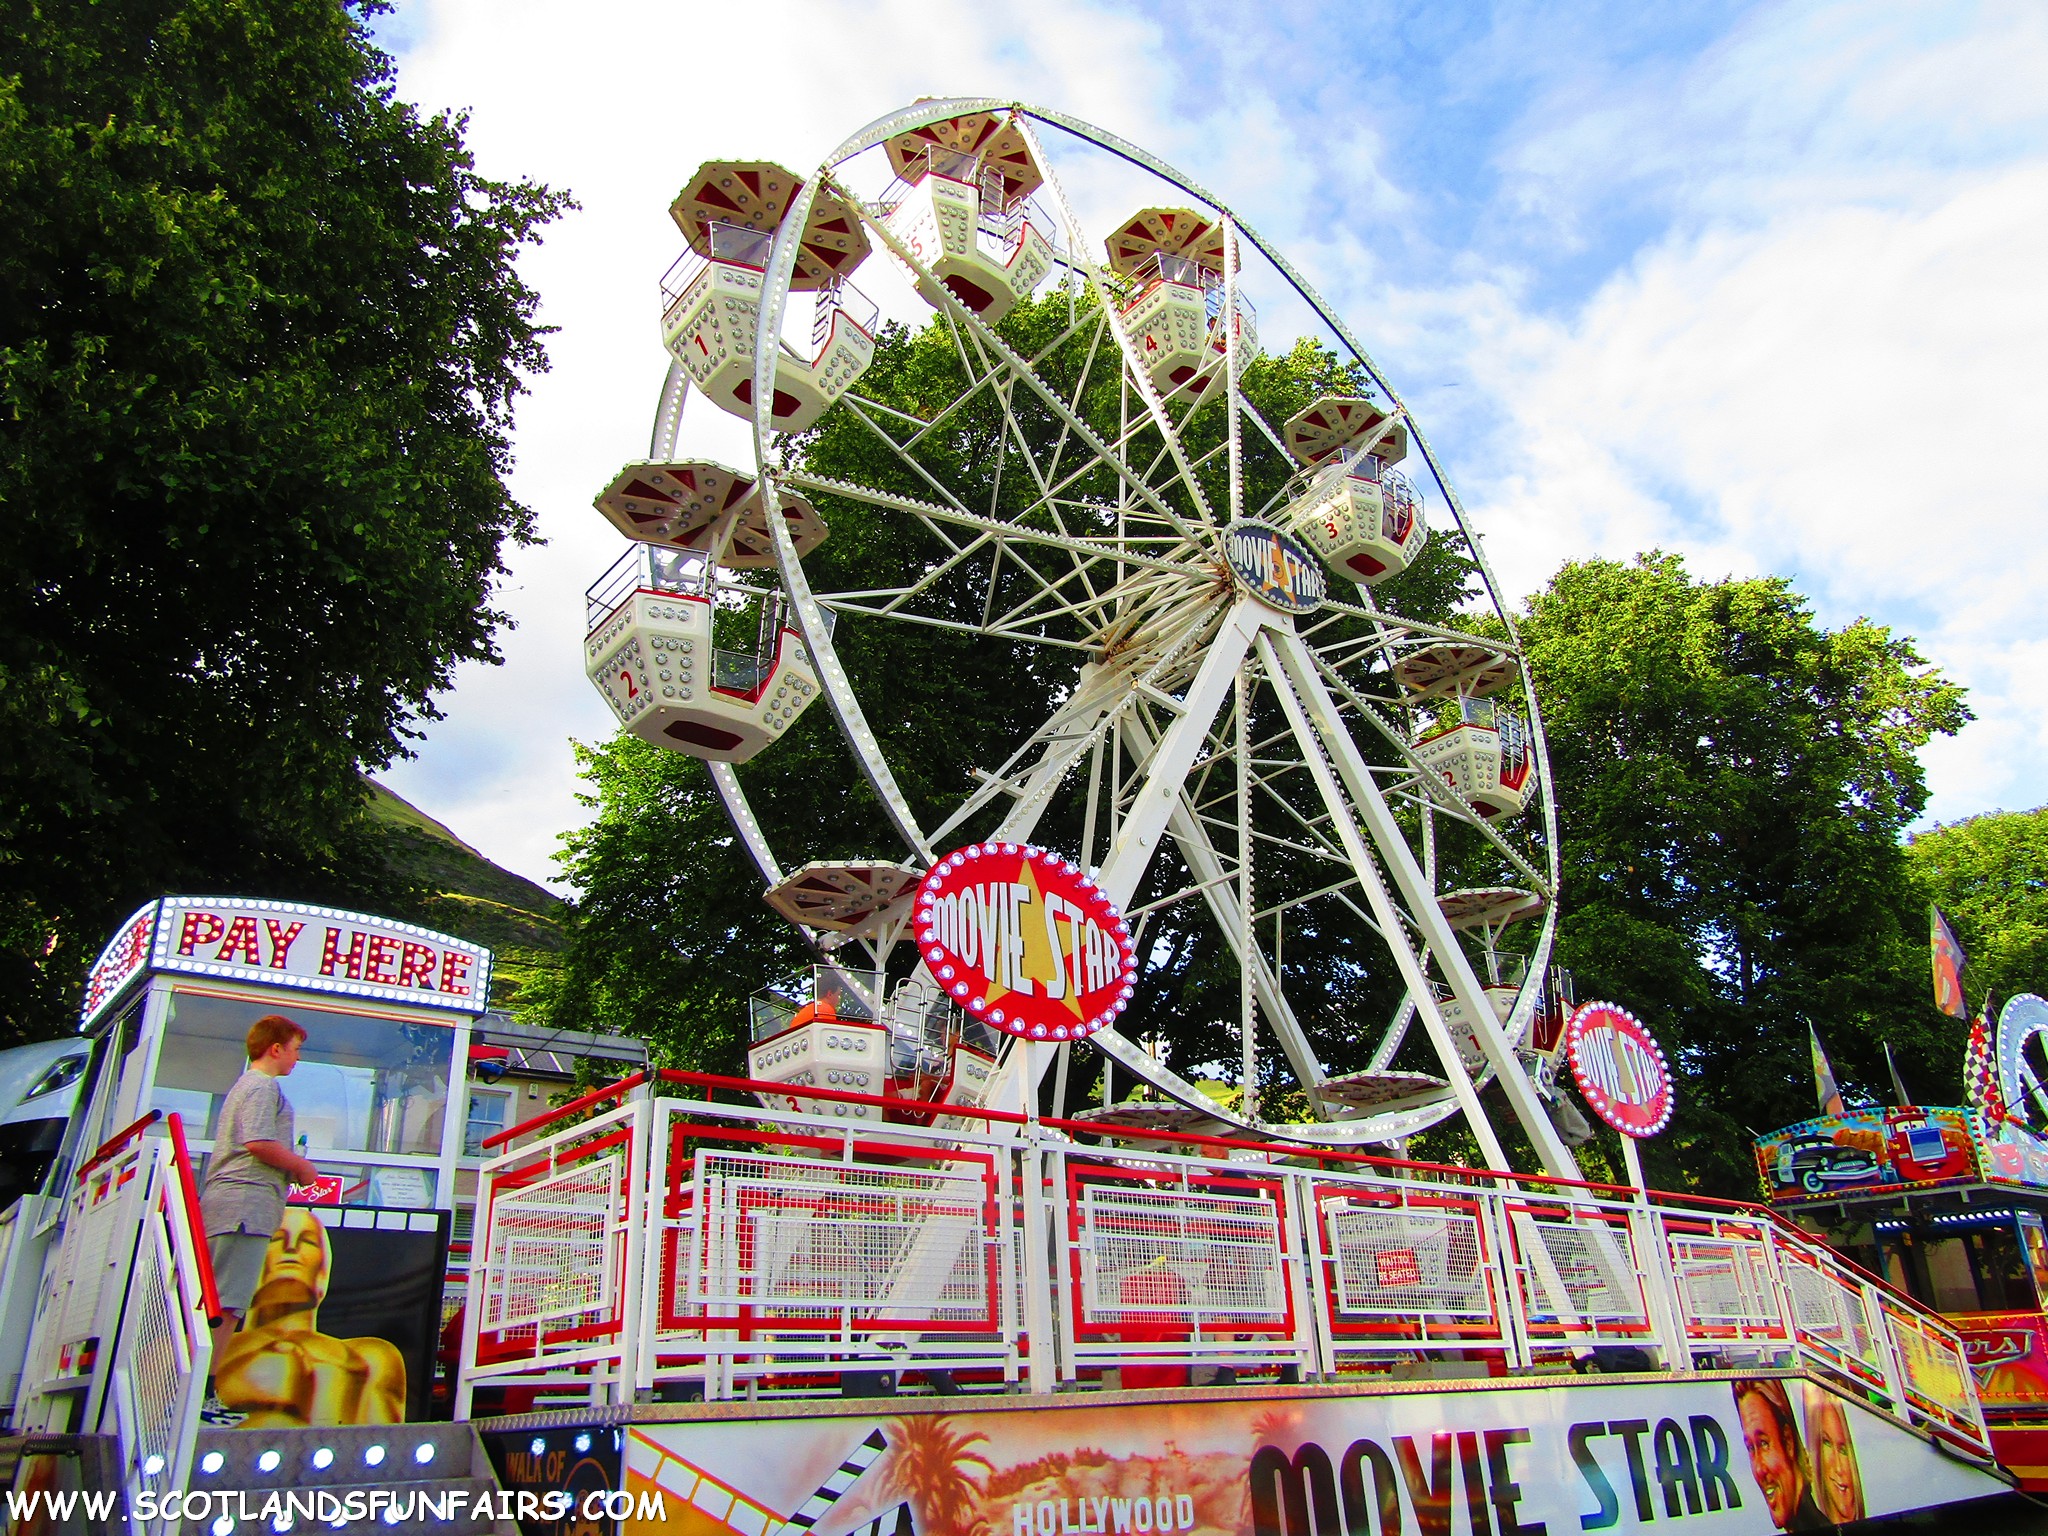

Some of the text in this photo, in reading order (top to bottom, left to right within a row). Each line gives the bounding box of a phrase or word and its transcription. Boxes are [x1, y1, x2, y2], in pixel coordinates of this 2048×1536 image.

[911, 236, 923, 257] 5
[694, 334, 708, 357] 1
[1145, 334, 1158, 353] 4
[1325, 522, 1339, 540] 3
[1232, 534, 1321, 598] MOVIE STAR
[620, 671, 639, 699] 2
[1442, 771, 1457, 787] 2
[932, 882, 1122, 999] MOVIE STAR
[177, 911, 307, 970] PAY
[319, 926, 473, 996] HERE
[1468, 1035, 1481, 1051] 1
[1578, 1027, 1662, 1105] MOVIE STAR
[307, 1185, 334, 1202] Star
[1398, 1255, 1409, 1264] TO
[1389, 1268, 1416, 1280] SEATED
[1962, 1336, 2021, 1356] ars
[506, 1450, 567, 1483] WALK OF
[1250, 1414, 1743, 1536] MOVIE STAR
[1012, 1494, 1195, 1536] HOLLYWOOD
